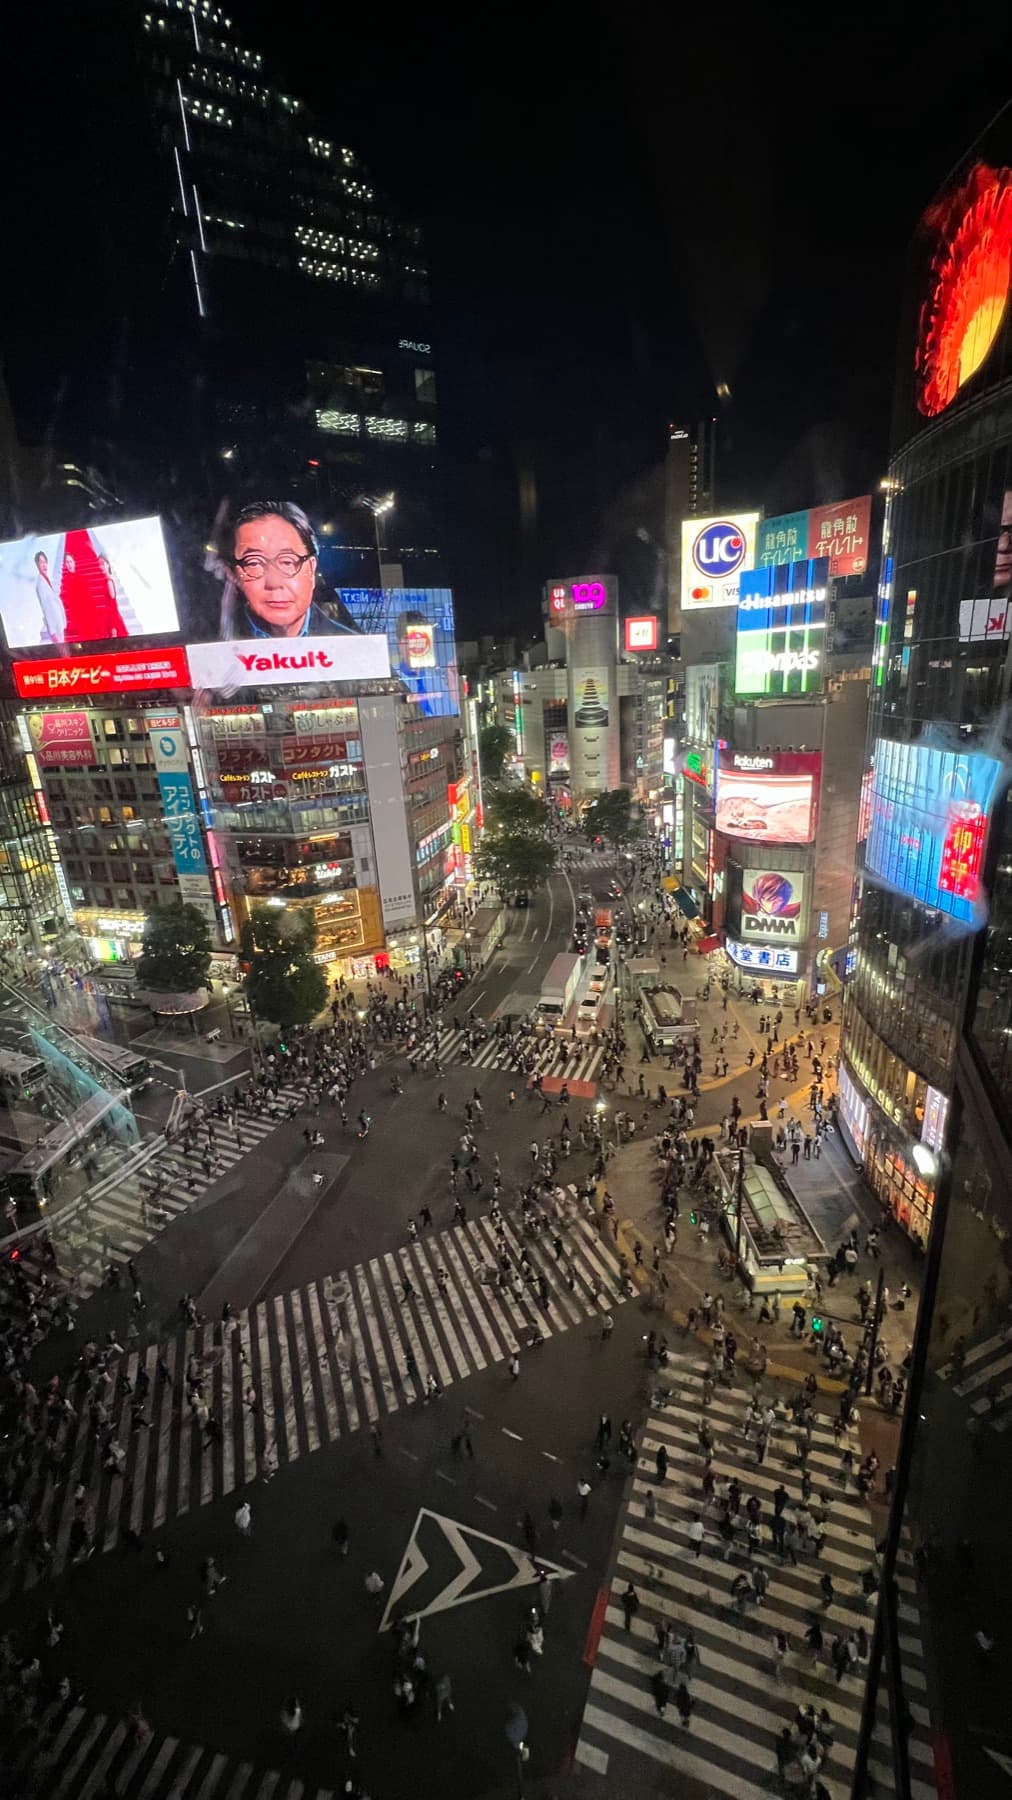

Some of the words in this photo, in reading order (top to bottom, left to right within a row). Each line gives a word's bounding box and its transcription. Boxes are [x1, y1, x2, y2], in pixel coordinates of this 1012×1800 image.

[820, 515, 857, 540] 龍角散
[700, 534, 741, 564] UC
[572, 582, 607, 610] 109
[740, 588, 826, 611] Hisamitsu
[236, 651, 334, 671] Yakult
[741, 650, 820, 675] onpas
[48, 665, 111, 688] 日本ダービー
[46, 750, 92, 762] 品川美容外科
[284, 744, 346, 763] コンタクト
[734, 755, 774, 769] Rakuten
[250, 771, 277, 784] ガスト
[329, 764, 358, 778] ガスト
[745, 916, 796, 935] DMM
